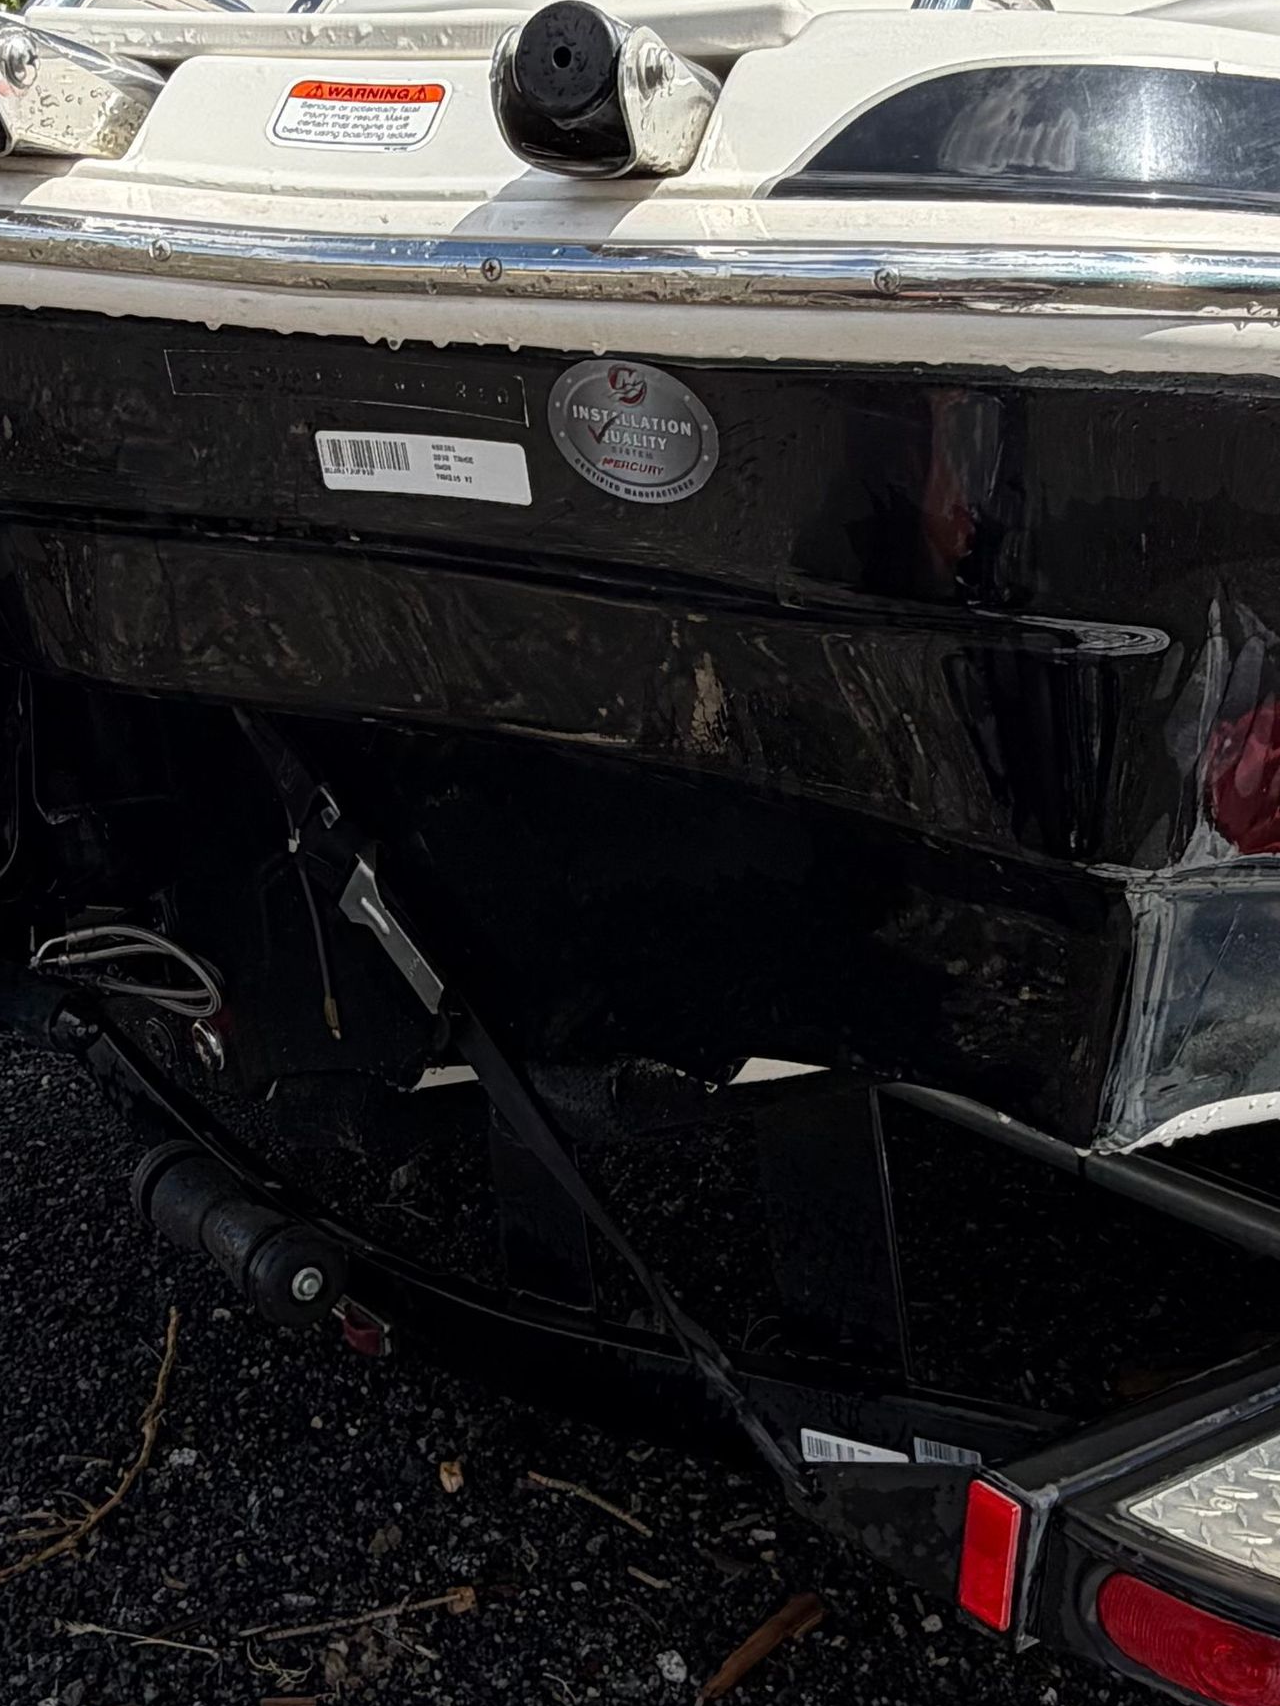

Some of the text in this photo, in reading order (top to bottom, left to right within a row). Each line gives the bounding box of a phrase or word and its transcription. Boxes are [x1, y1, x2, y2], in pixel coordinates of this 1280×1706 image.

[327, 85, 410, 101] WARNING
[300, 100, 422, 115] Serious or potentially fatal
[303, 111, 328, 122] injury
[331, 113, 351, 122] may
[384, 114, 411, 122] Make
[281, 125, 312, 136] before
[314, 129, 339, 140] using
[297, 119, 329, 129] certain
[351, 122, 384, 132] engine
[396, 122, 410, 130] off
[572, 404, 692, 437] INSTALLATION
[601, 456, 664, 475] MERCURY
